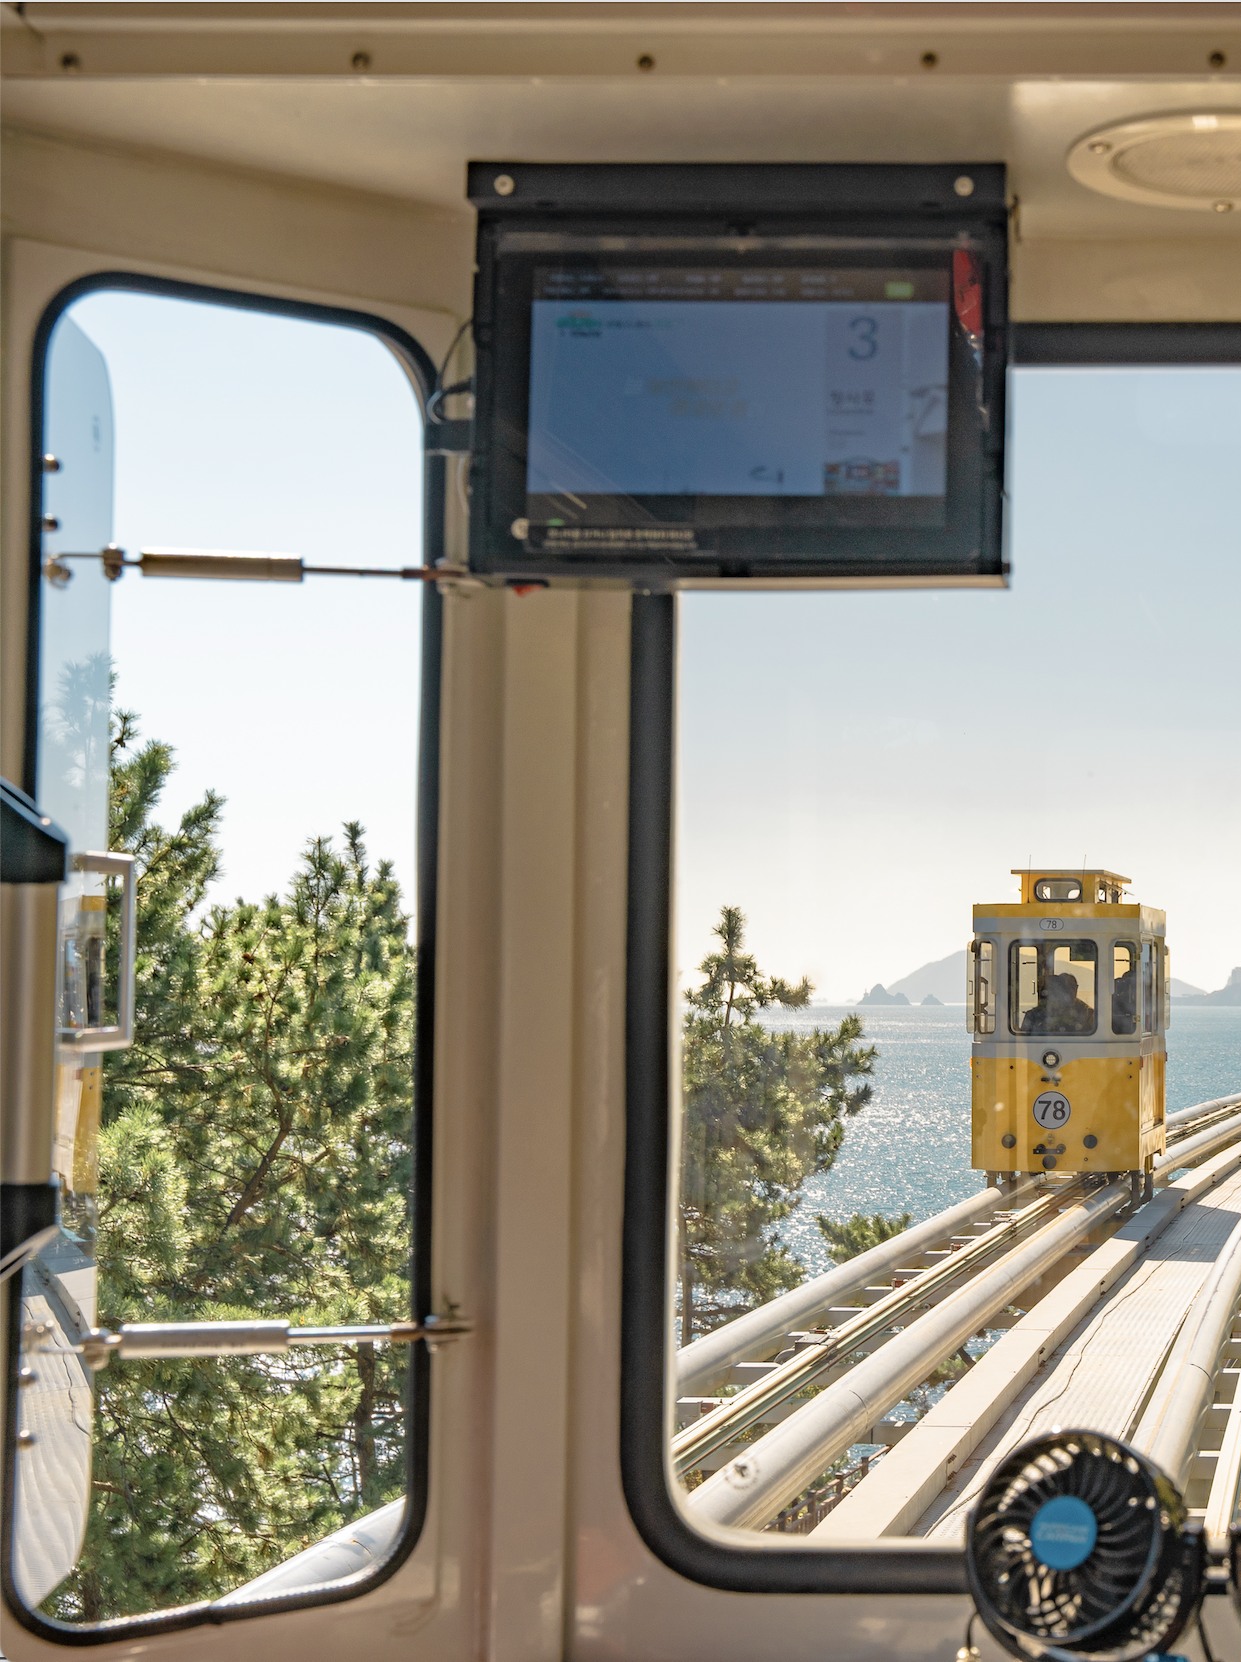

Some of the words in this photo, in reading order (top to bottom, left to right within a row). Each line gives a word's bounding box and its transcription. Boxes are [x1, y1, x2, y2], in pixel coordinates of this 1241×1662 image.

[849, 316, 877, 360] 3
[1046, 920, 1057, 929] 78
[1038, 1100, 1066, 1120] 78
